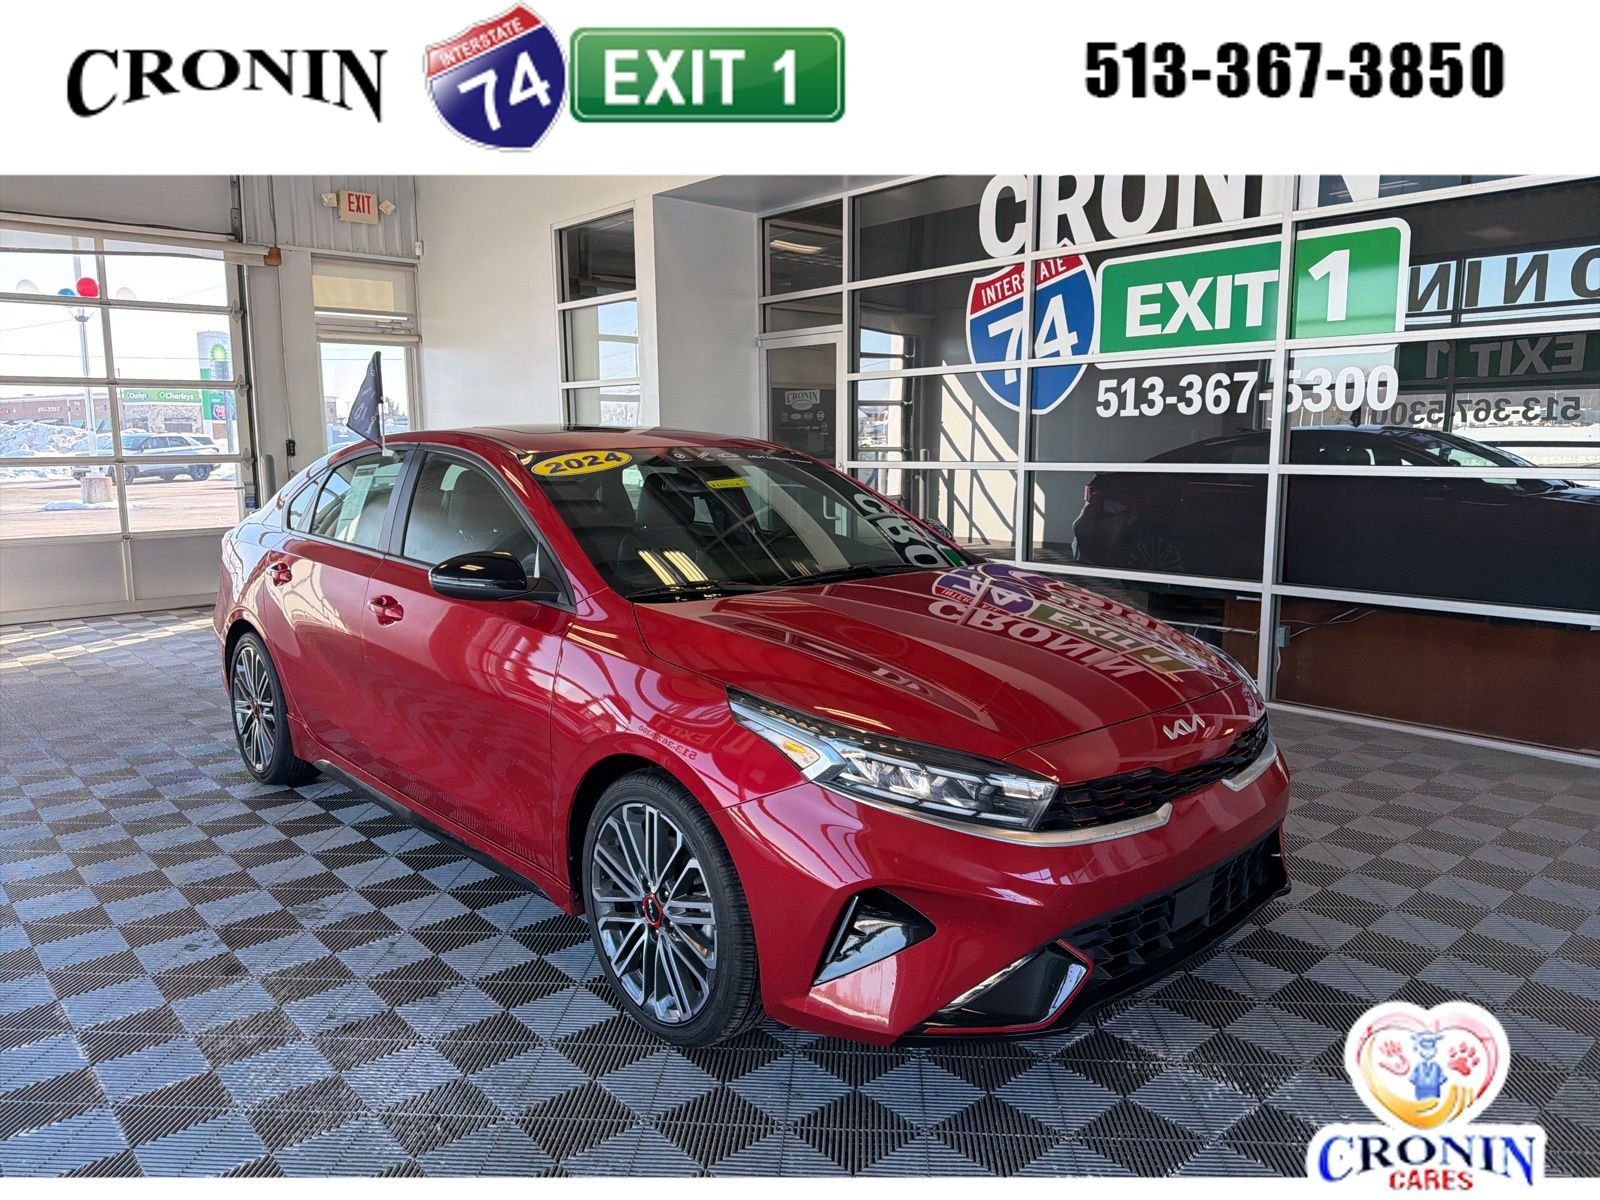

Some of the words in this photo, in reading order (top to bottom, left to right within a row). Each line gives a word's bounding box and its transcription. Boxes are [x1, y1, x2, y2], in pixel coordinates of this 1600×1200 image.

[347, 192, 372, 215] EXIT
[981, 257, 1067, 307] INTERSATE
[1125, 269, 1280, 338] EXIT
[1307, 248, 1351, 322] 1
[987, 293, 1079, 385] 74
[786, 391, 818, 404] CRONIN
[1096, 365, 1399, 418] 513-367-5300
[544, 452, 623, 474] 2024
